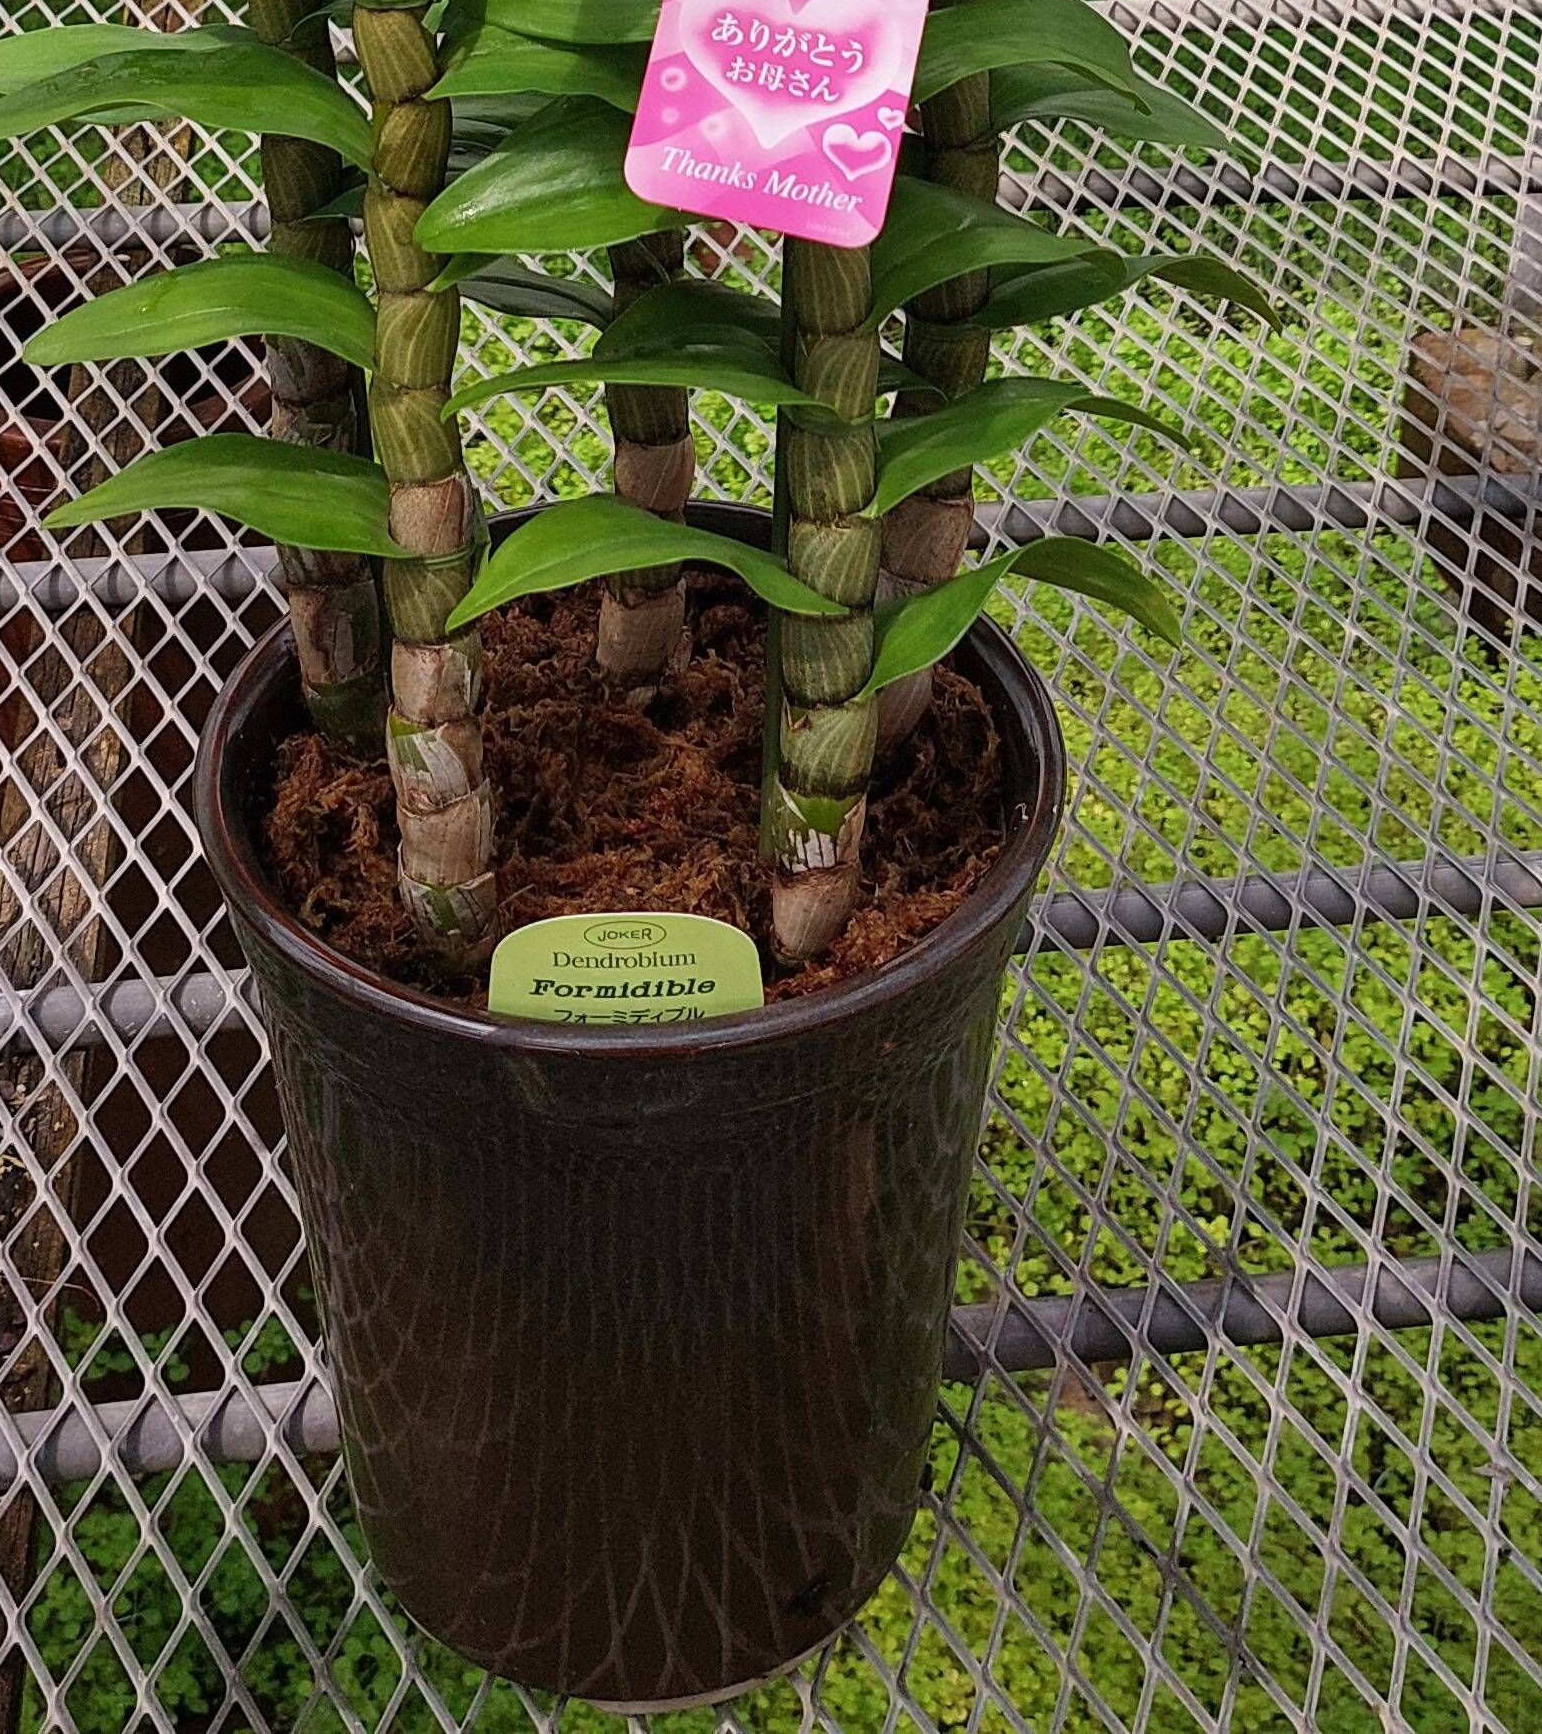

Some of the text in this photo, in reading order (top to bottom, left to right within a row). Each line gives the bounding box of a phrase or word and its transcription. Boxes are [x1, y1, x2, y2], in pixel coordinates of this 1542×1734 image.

[711, 13, 864, 74] ありがとう
[725, 56, 839, 103] お母さん
[660, 146, 863, 213] Thanks Mother
[597, 927, 652, 942] JOKER
[552, 951, 697, 969] Dendrobium
[529, 978, 716, 999] Formidible
